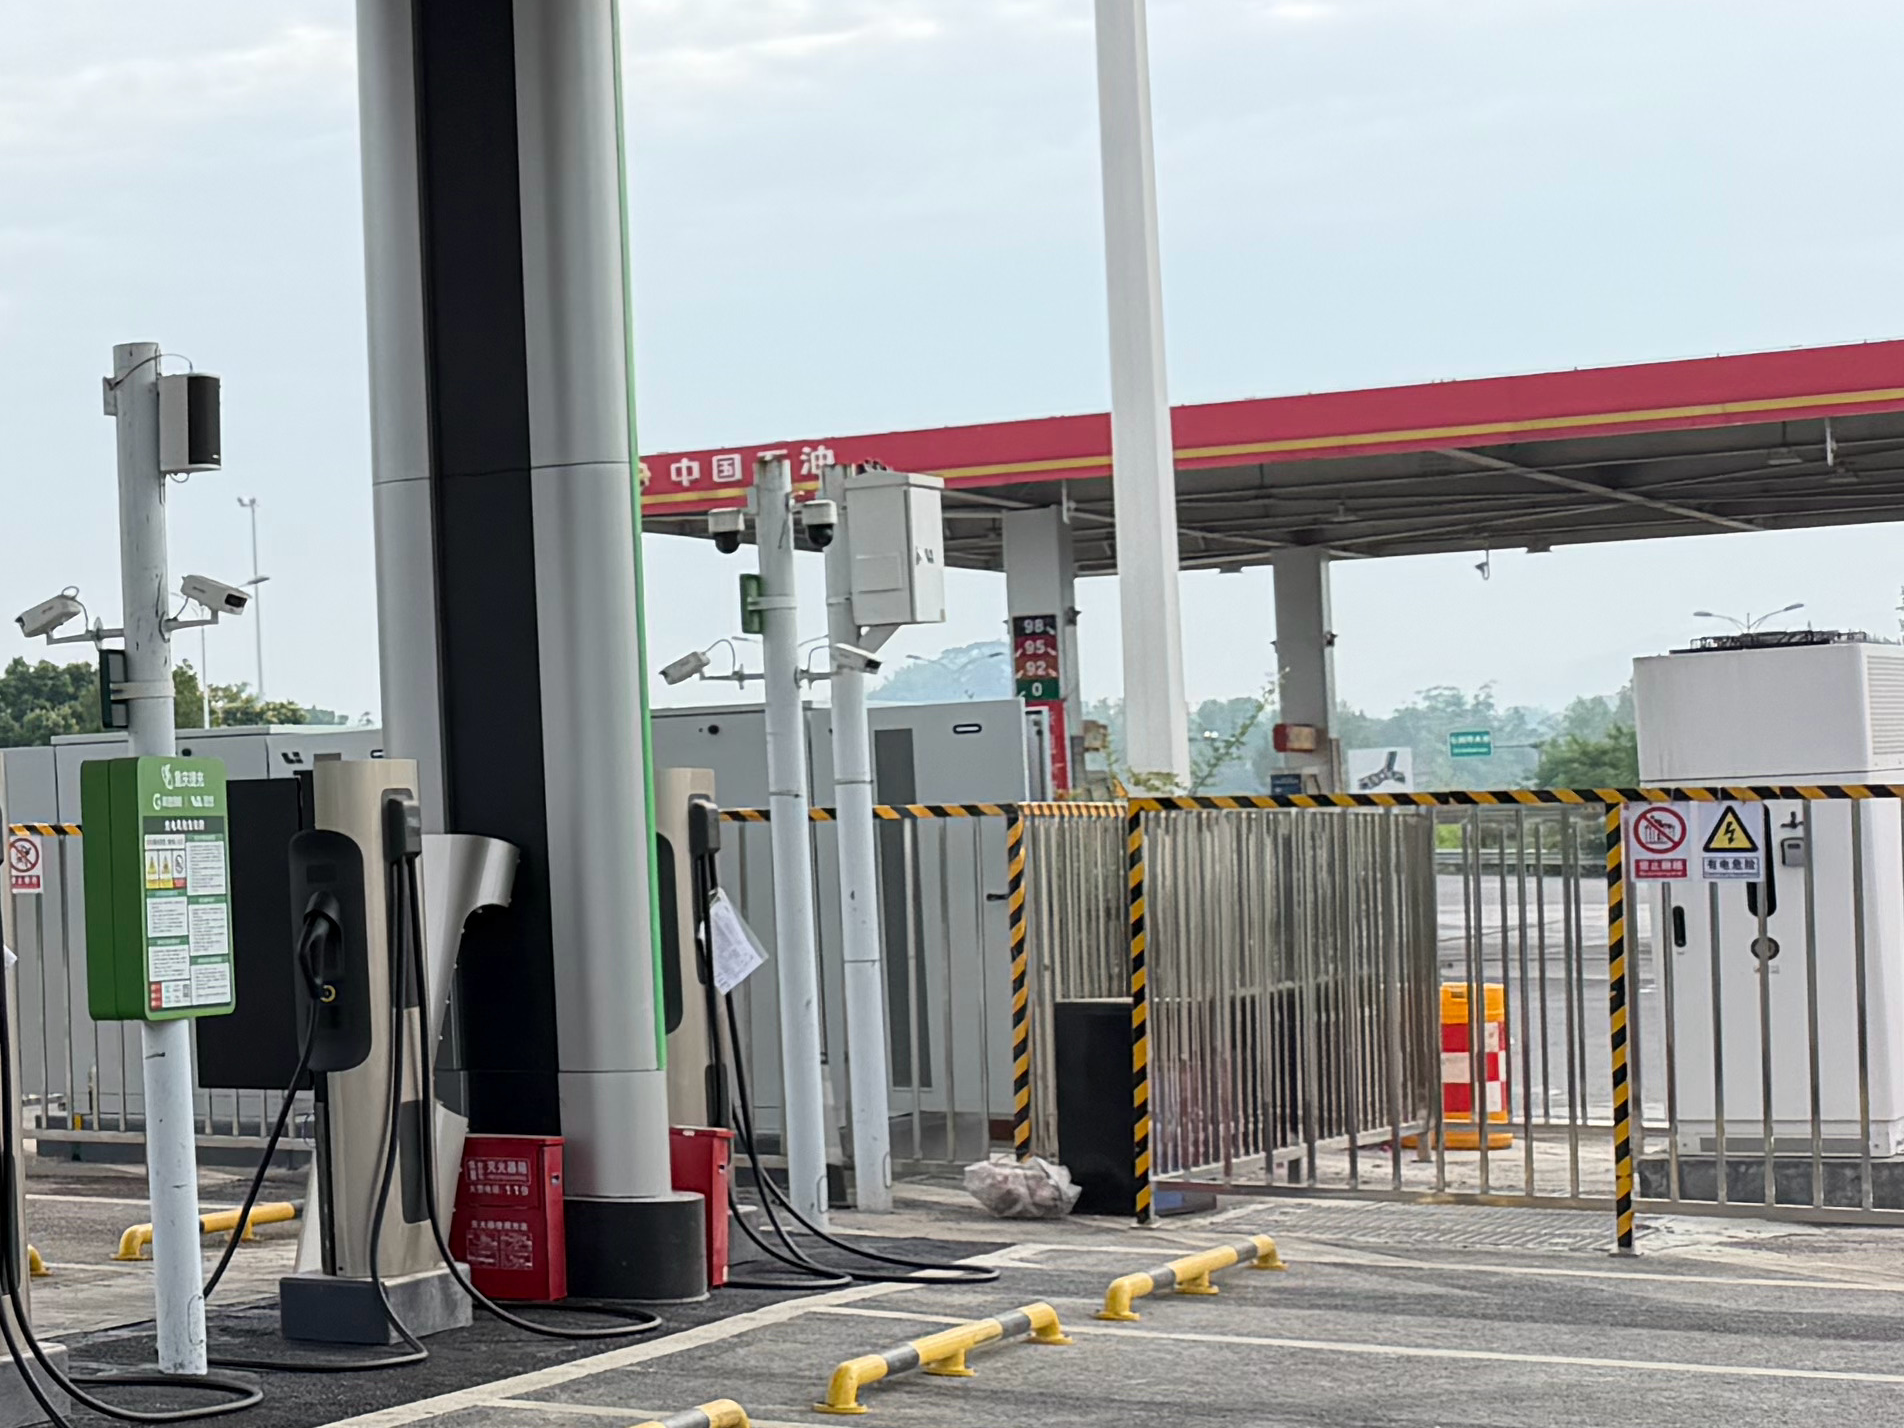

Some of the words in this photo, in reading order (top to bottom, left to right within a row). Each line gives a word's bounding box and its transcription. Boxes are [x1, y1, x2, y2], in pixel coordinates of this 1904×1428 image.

[670, 445, 836, 487] 中国油
[1024, 619, 1044, 634] 98
[1024, 640, 1046, 655] 95
[1025, 661, 1047, 676] 92
[1032, 682, 1043, 697] 0
[1707, 859, 1756, 870] 有电危险
